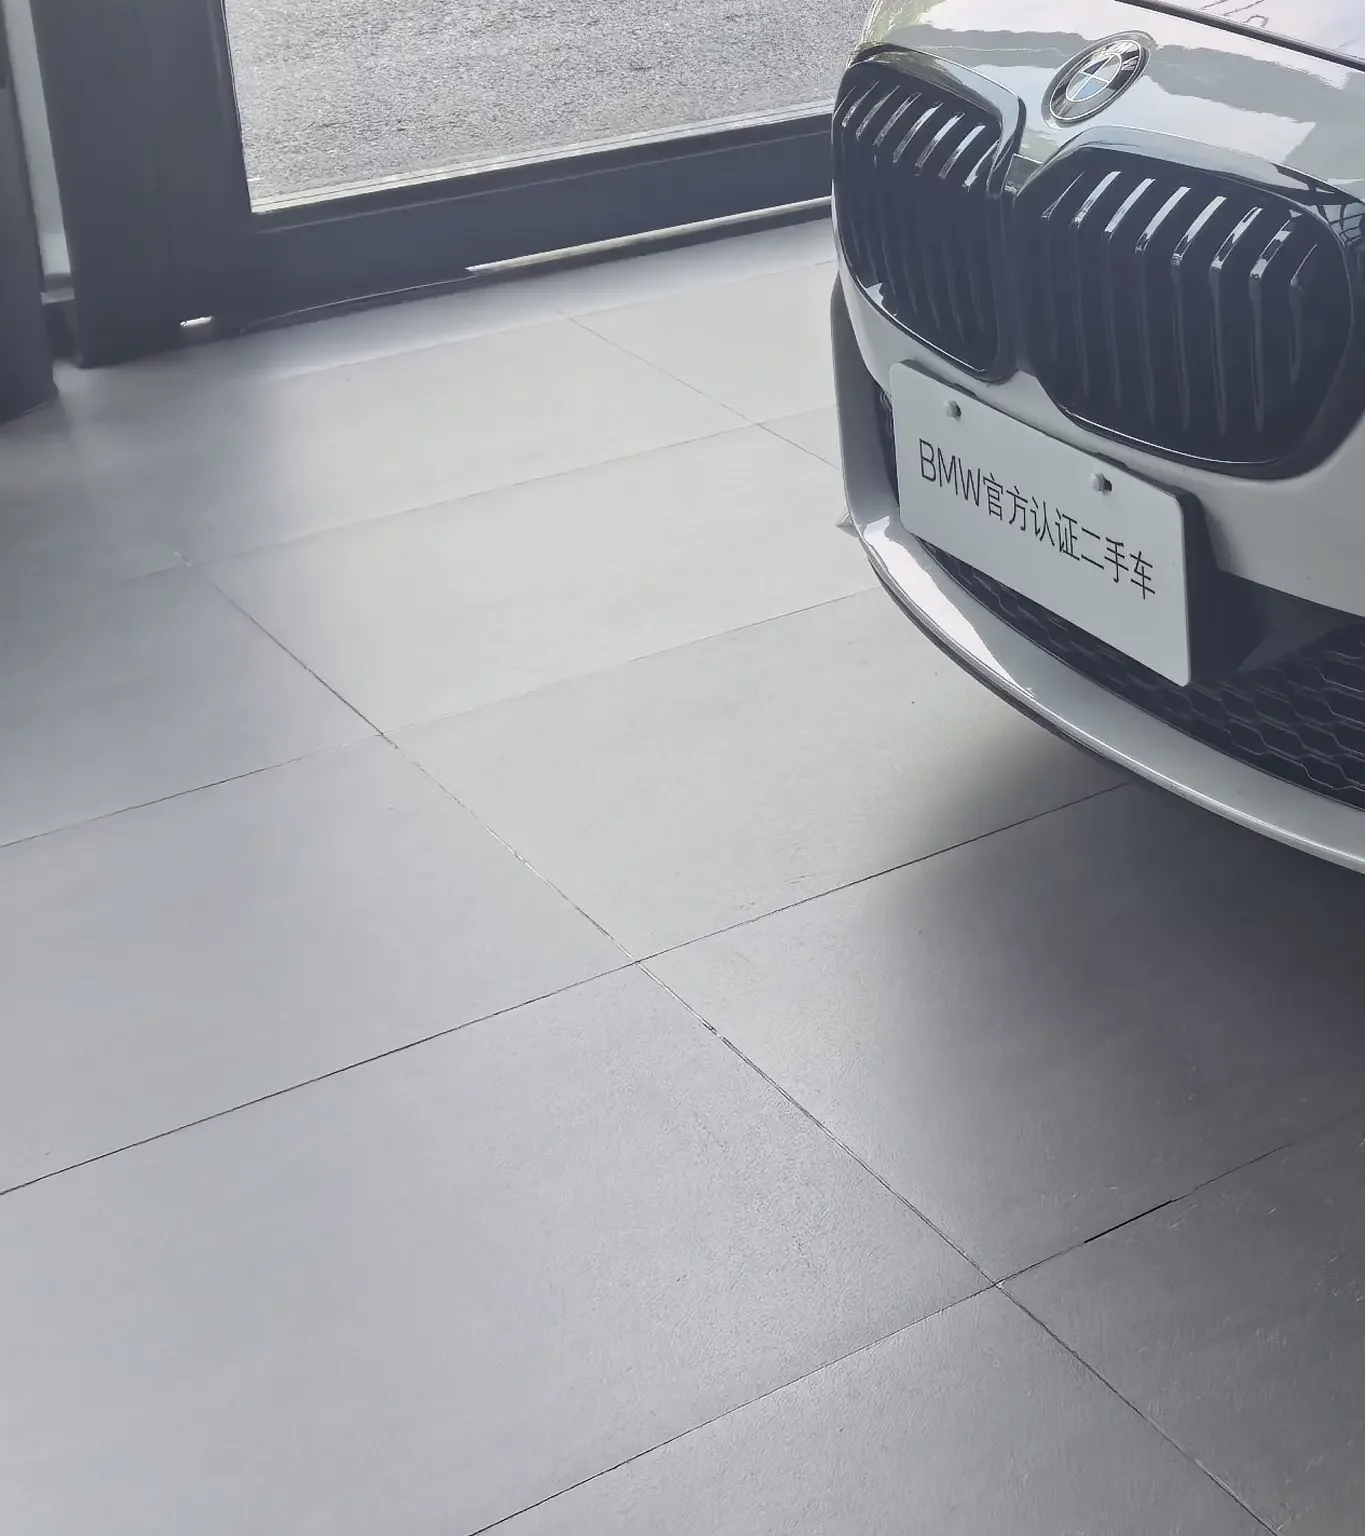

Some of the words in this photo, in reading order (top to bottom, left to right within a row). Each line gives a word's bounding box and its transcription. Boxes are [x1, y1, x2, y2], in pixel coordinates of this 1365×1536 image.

[918, 437, 1156, 600] BMW官方认证二手车
